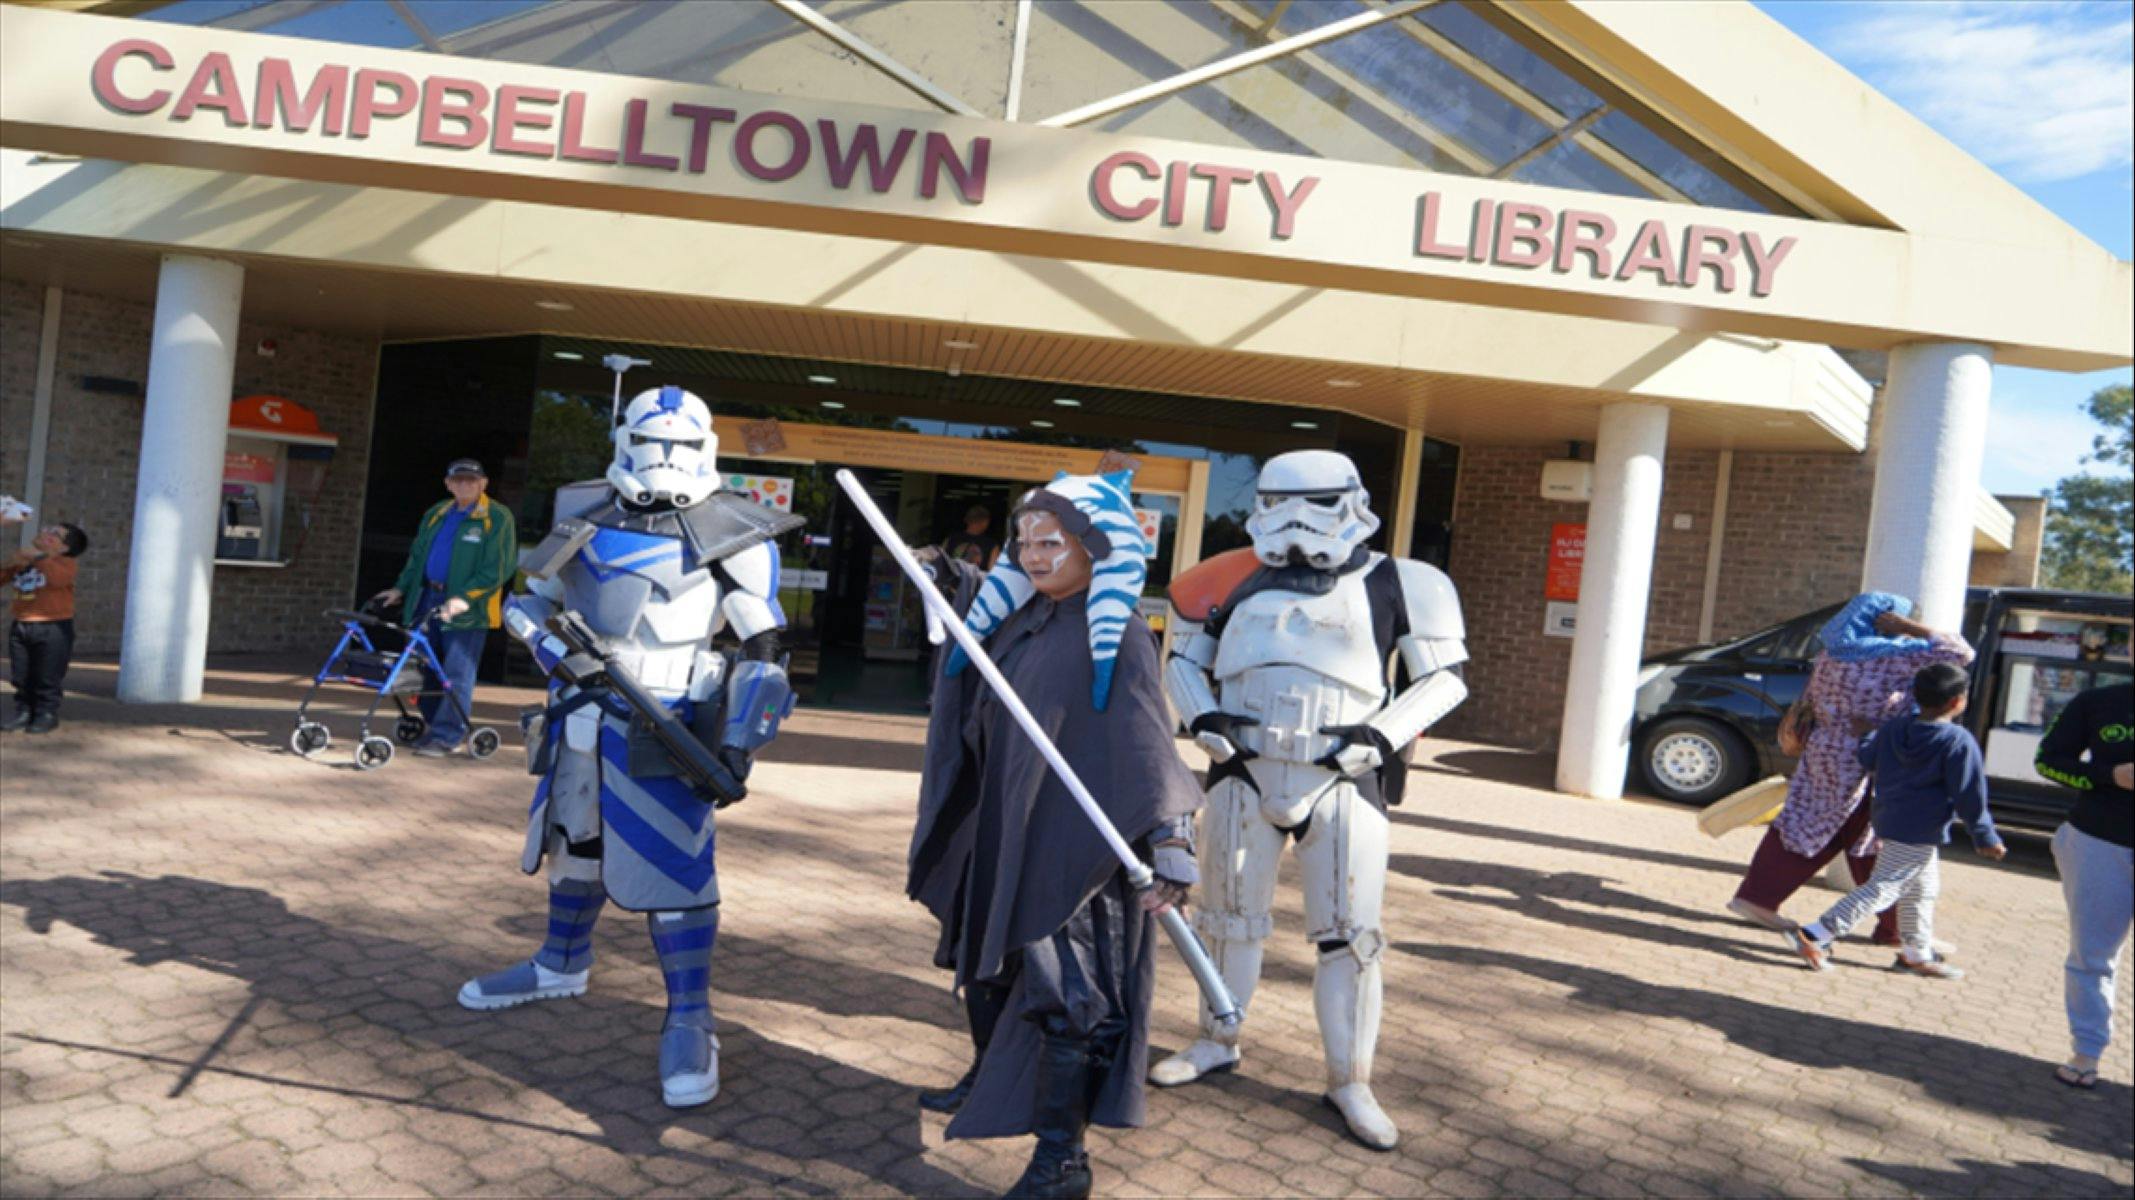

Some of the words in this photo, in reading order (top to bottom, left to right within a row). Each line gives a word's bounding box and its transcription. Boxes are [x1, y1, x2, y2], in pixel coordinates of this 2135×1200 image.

[92, 39, 992, 205] CAMPBELLTOWN
[1092, 151, 1320, 239] CITY
[1415, 191, 1798, 297] LIBRARY
